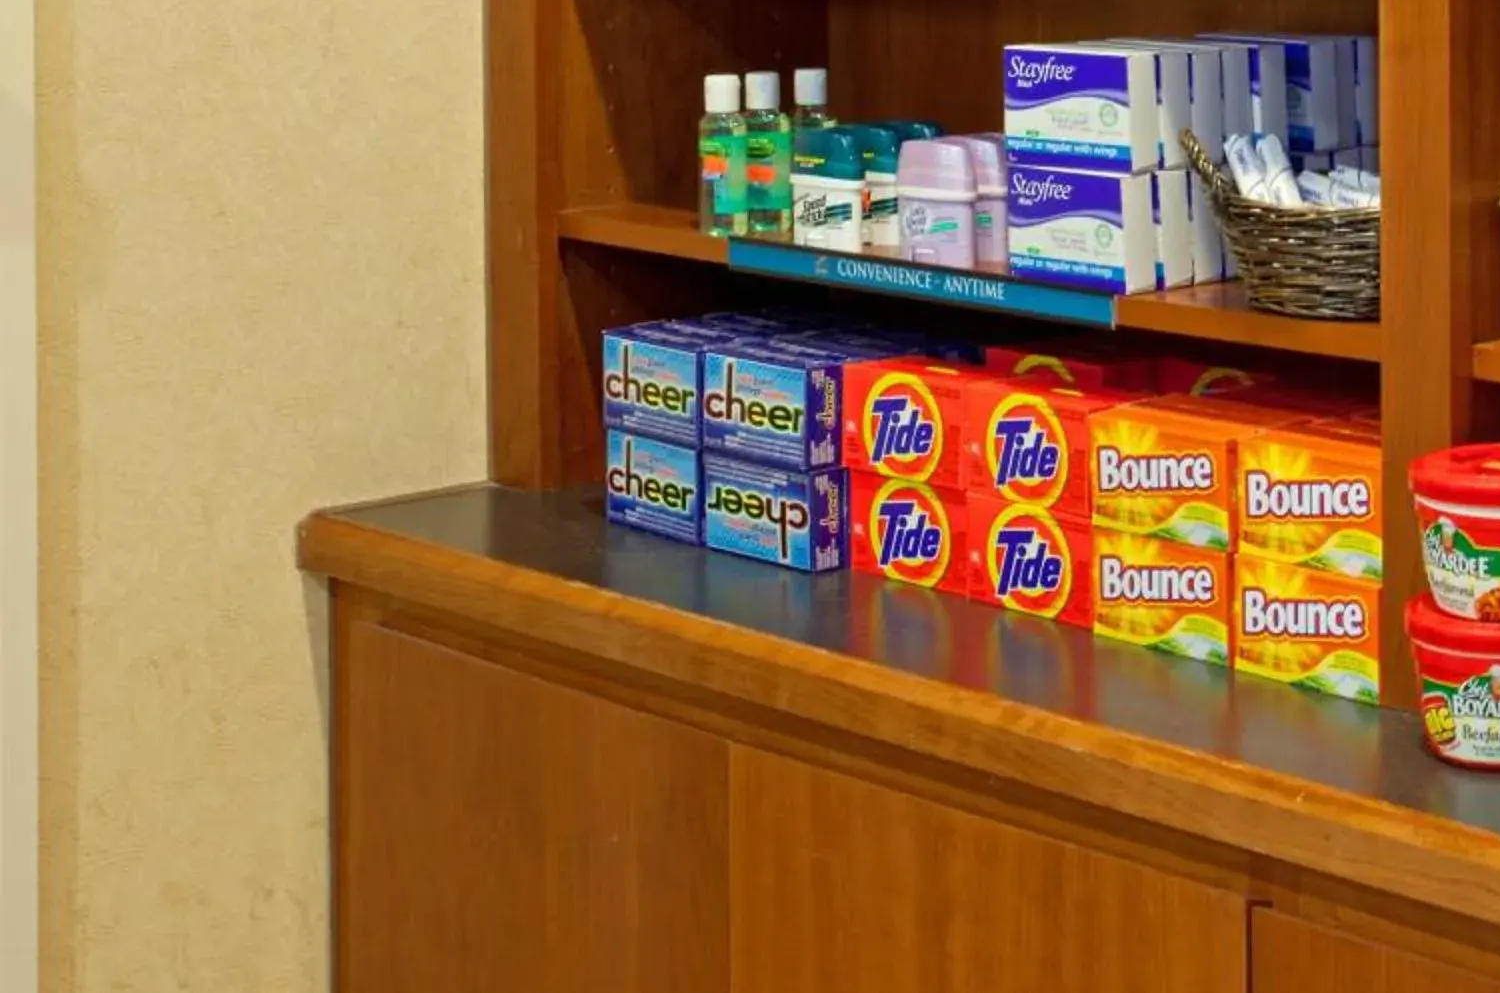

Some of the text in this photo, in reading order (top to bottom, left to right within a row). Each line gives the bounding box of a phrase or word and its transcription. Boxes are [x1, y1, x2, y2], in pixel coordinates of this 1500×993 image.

[1008, 55, 1076, 82] Stayfree
[1010, 173, 1073, 203] Stayfree
[837, 258, 932, 288] CONVENIENCE
[943, 275, 1005, 299] ANYTIME
[606, 344, 694, 413] cheer
[704, 361, 804, 433] cheer
[871, 397, 935, 465] Tide
[995, 418, 1060, 488] Tide
[608, 438, 695, 510] cheer
[1098, 446, 1213, 491] Bounce
[1247, 472, 1370, 516] Bounce
[707, 486, 809, 559] cheer
[878, 502, 943, 568] Tide
[996, 527, 1062, 597] Tide
[1101, 556, 1213, 601] Bounce
[1244, 590, 1364, 636] Bounce
